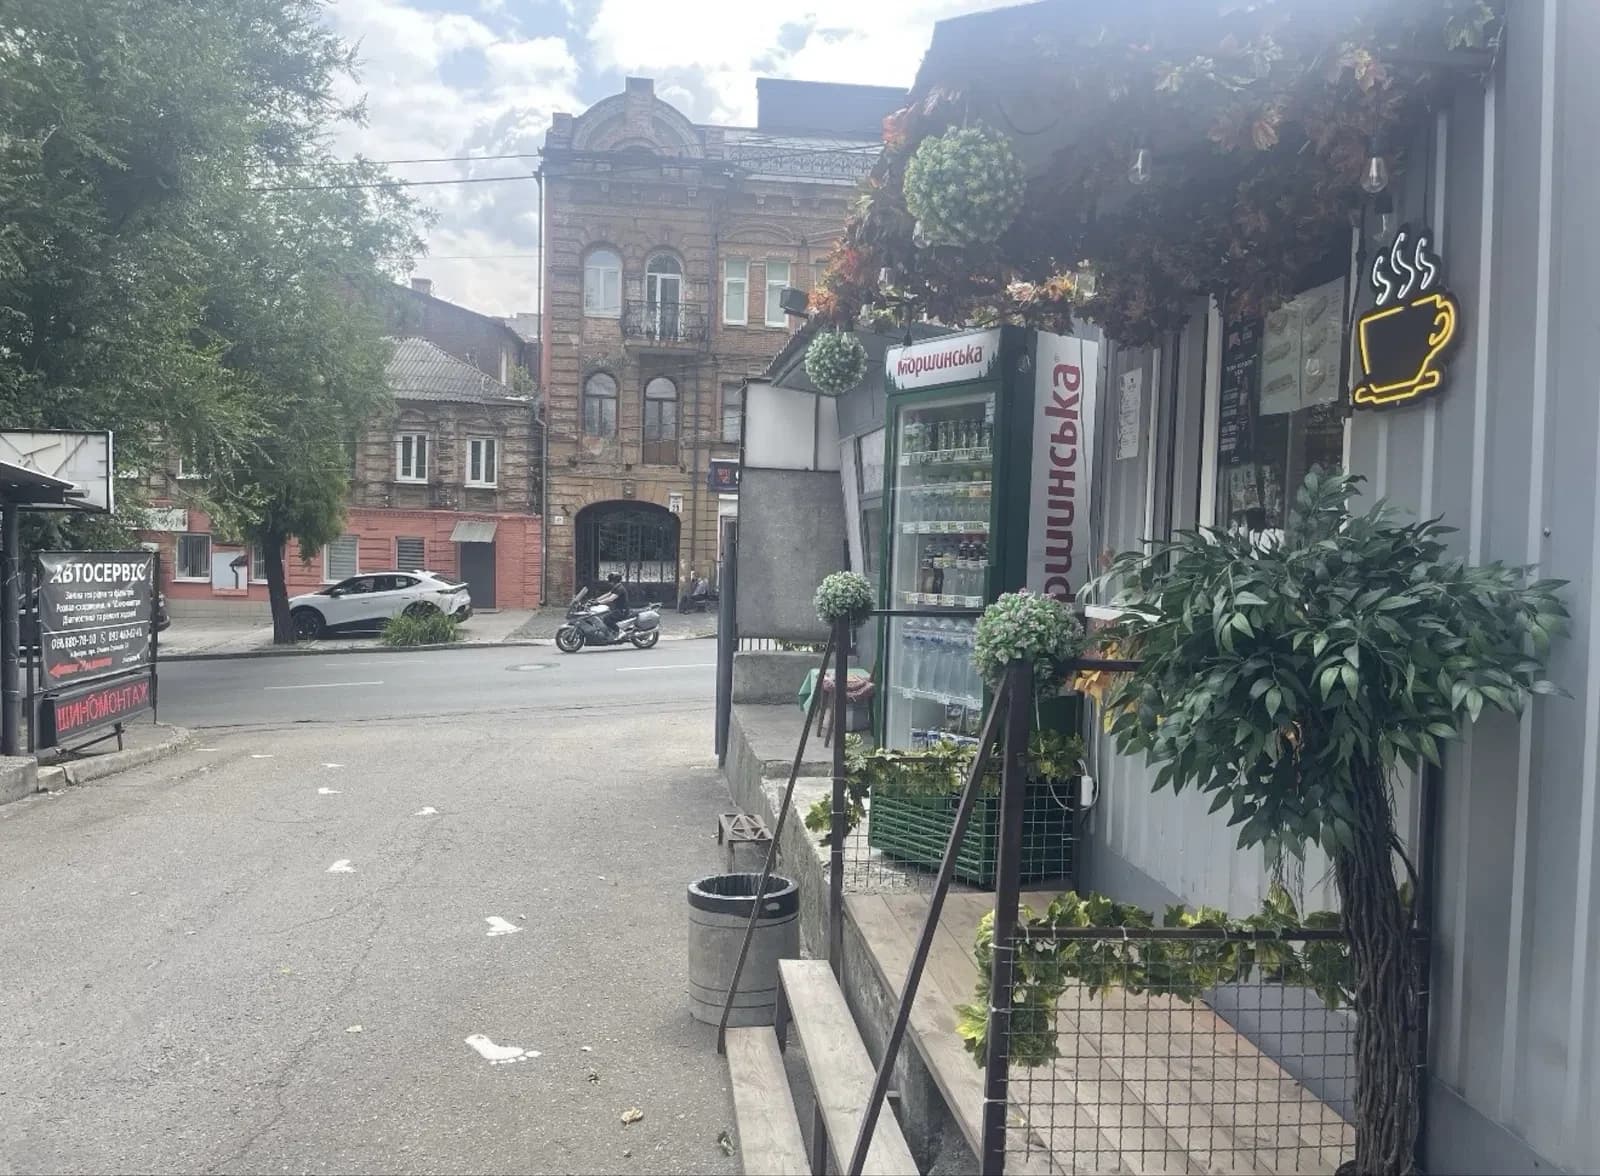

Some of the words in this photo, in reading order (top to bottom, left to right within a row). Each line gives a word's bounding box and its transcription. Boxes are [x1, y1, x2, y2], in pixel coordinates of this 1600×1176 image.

[898, 344, 983, 377] моршинська
[1044, 363, 1081, 604] ршинська
[50, 563, 146, 584] АВТОСЕРВІС
[57, 682, 148, 732] ШИНОМОНТАЖ
